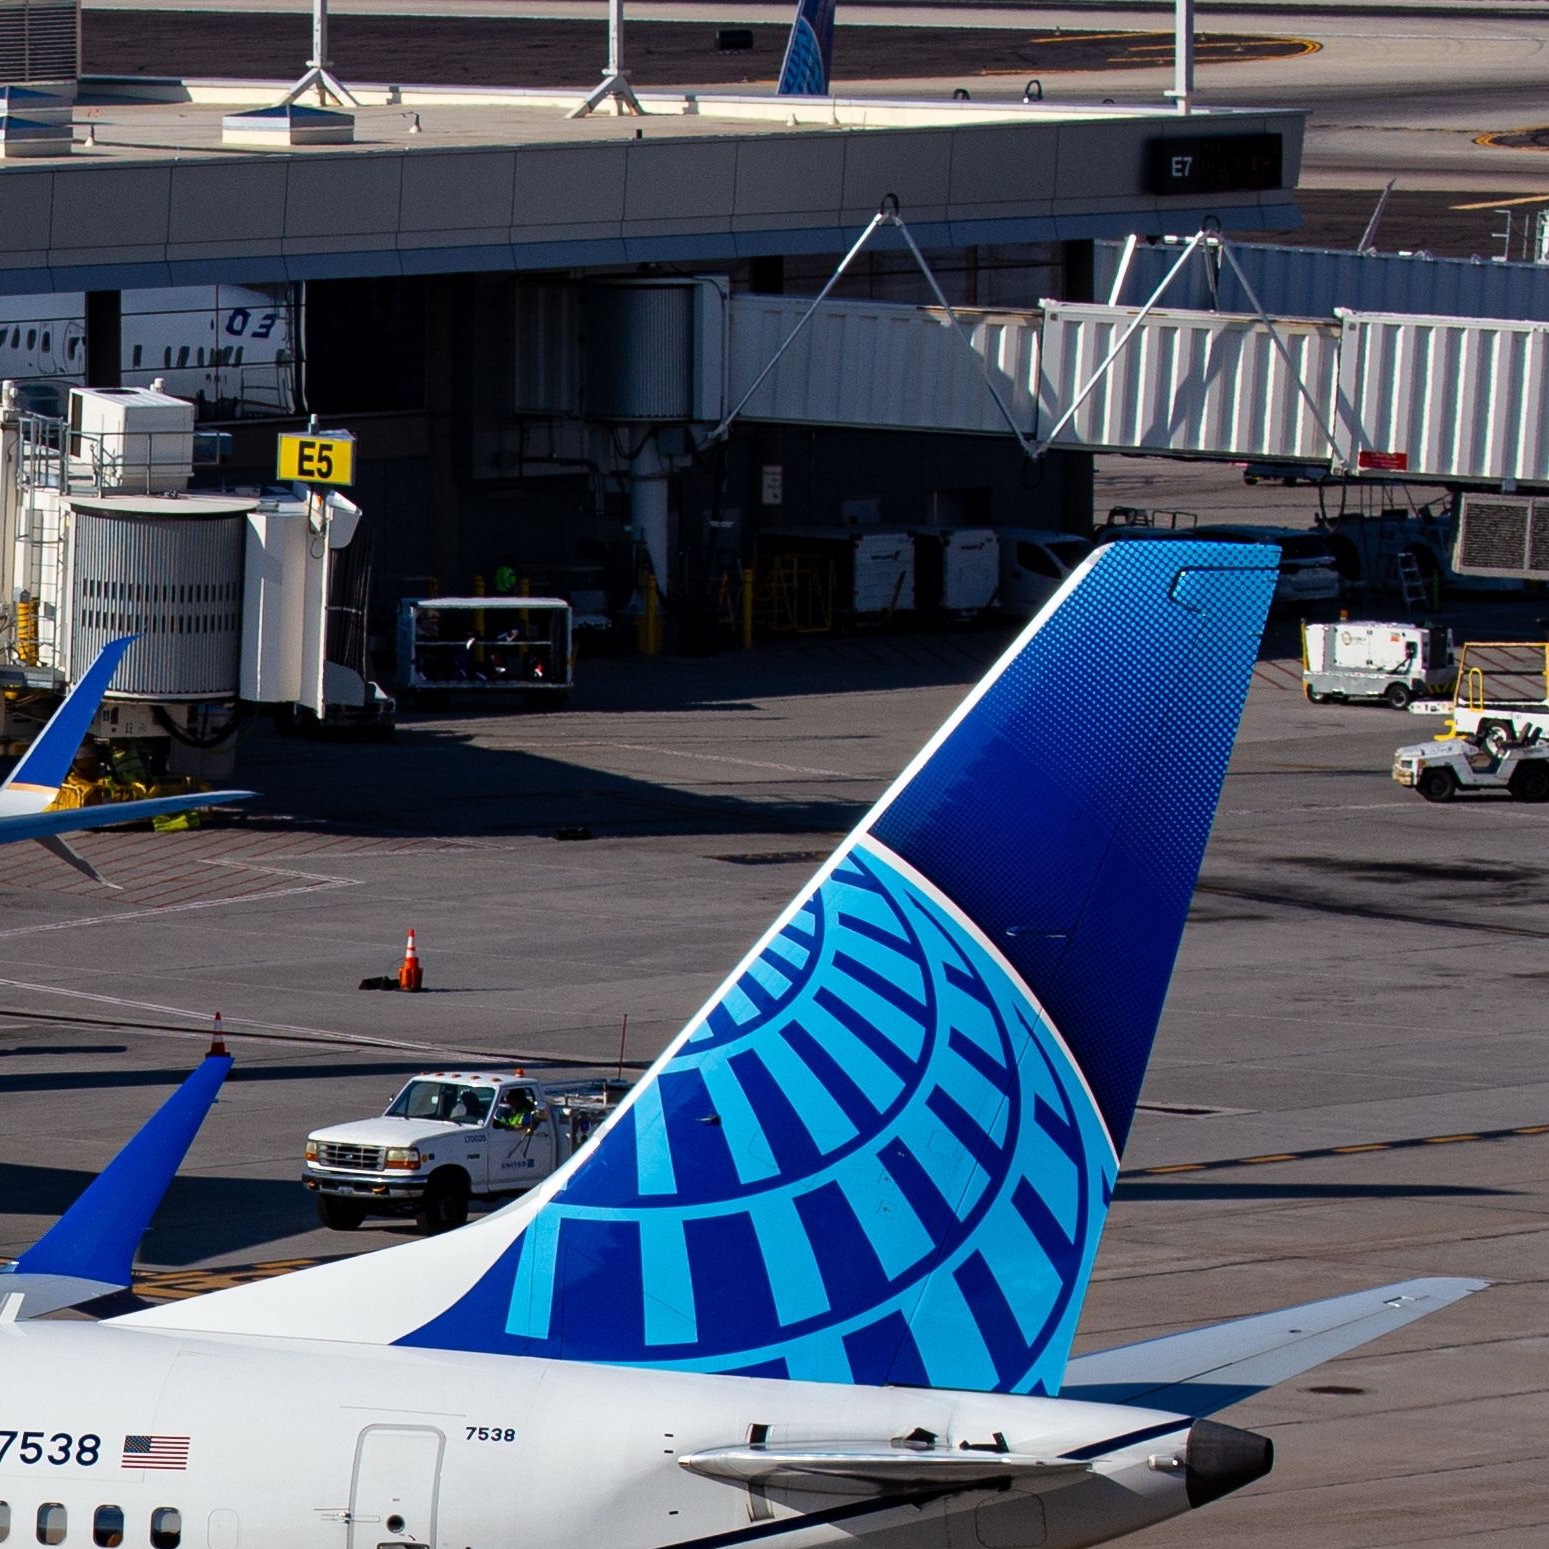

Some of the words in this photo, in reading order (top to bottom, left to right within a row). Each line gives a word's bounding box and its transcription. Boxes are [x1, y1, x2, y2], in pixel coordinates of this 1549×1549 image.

[1171, 156, 1193, 177] E7
[299, 441, 331, 478] E5
[466, 1426, 515, 1443] 7538
